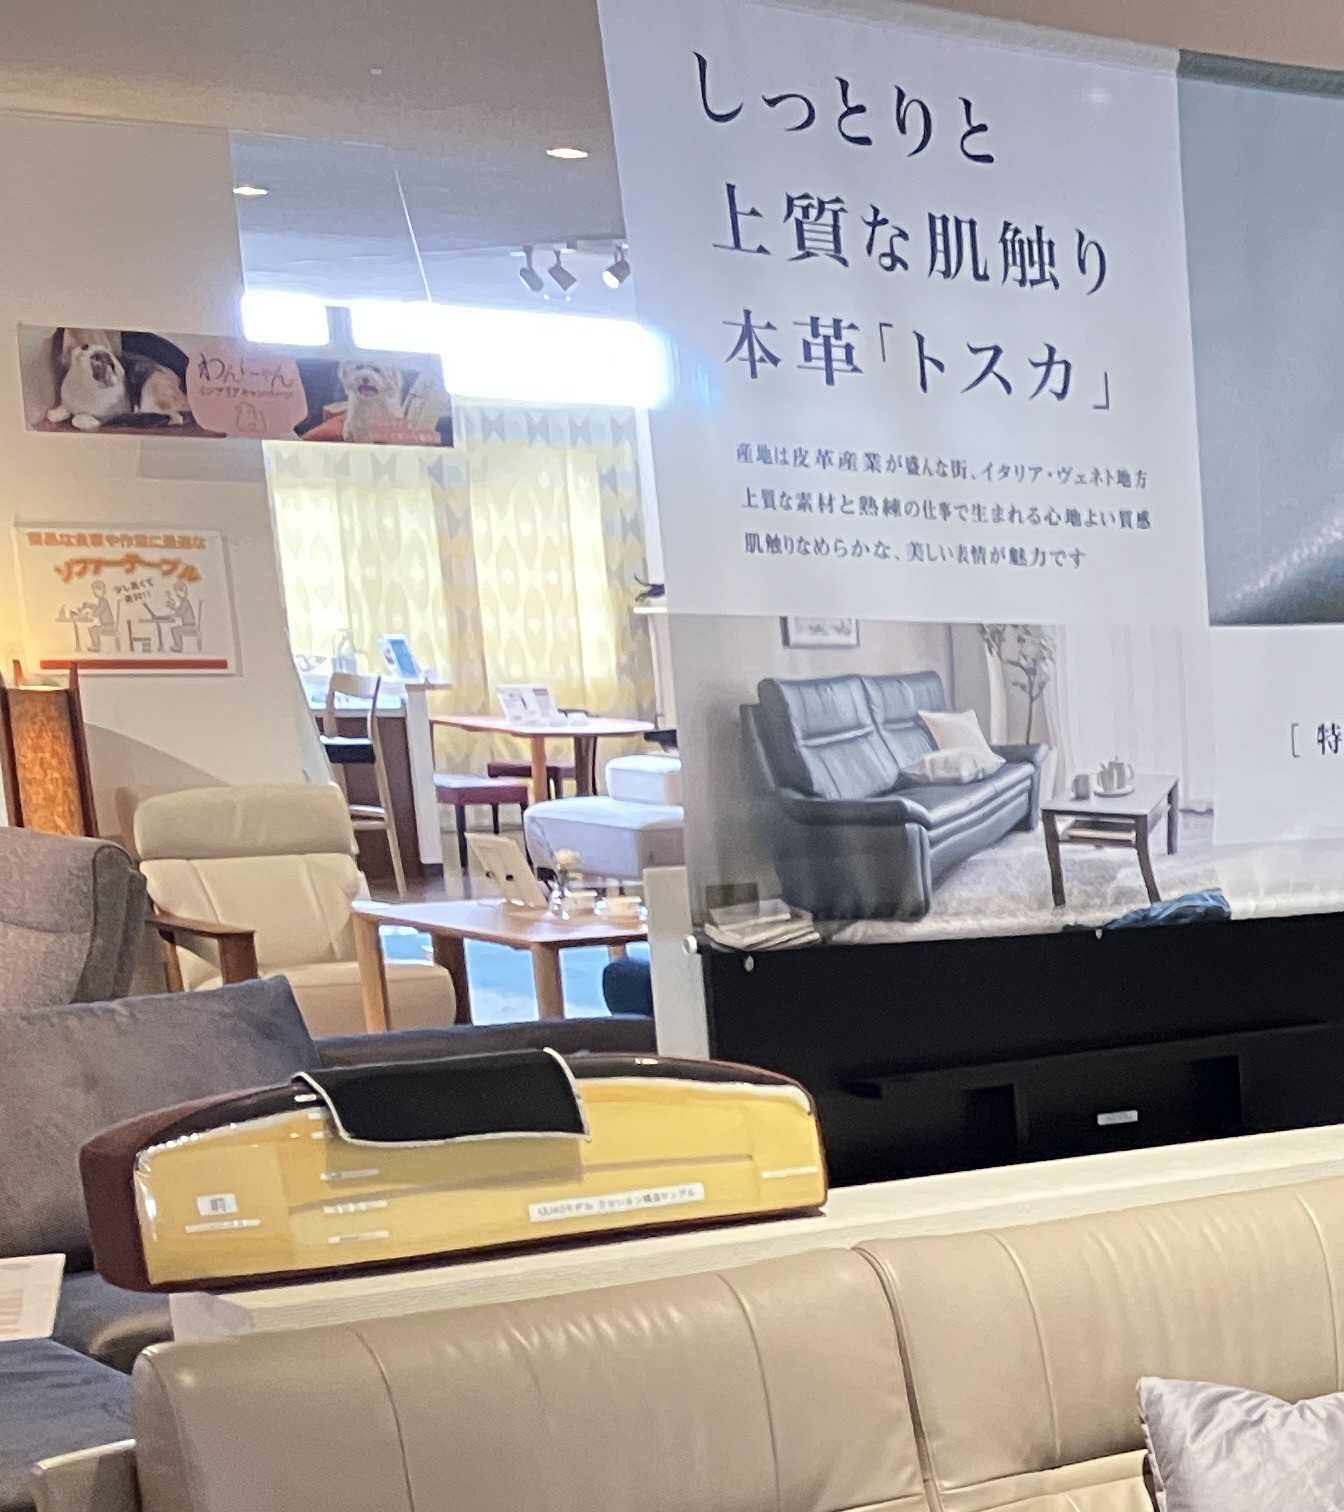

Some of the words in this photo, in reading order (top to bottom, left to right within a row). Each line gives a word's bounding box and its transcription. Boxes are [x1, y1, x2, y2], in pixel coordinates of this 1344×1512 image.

[692, 50, 996, 164] しっとりと
[712, 183, 1108, 296] 上質な肌触り
[721, 308, 1111, 411] 本革「トスカ」
[741, 487, 1151, 530] 上質な素材と熟練の仕事で生まれる心地よい質感
[744, 532, 1087, 569] 肌触りなめらかな、美しい表情が魅力です
